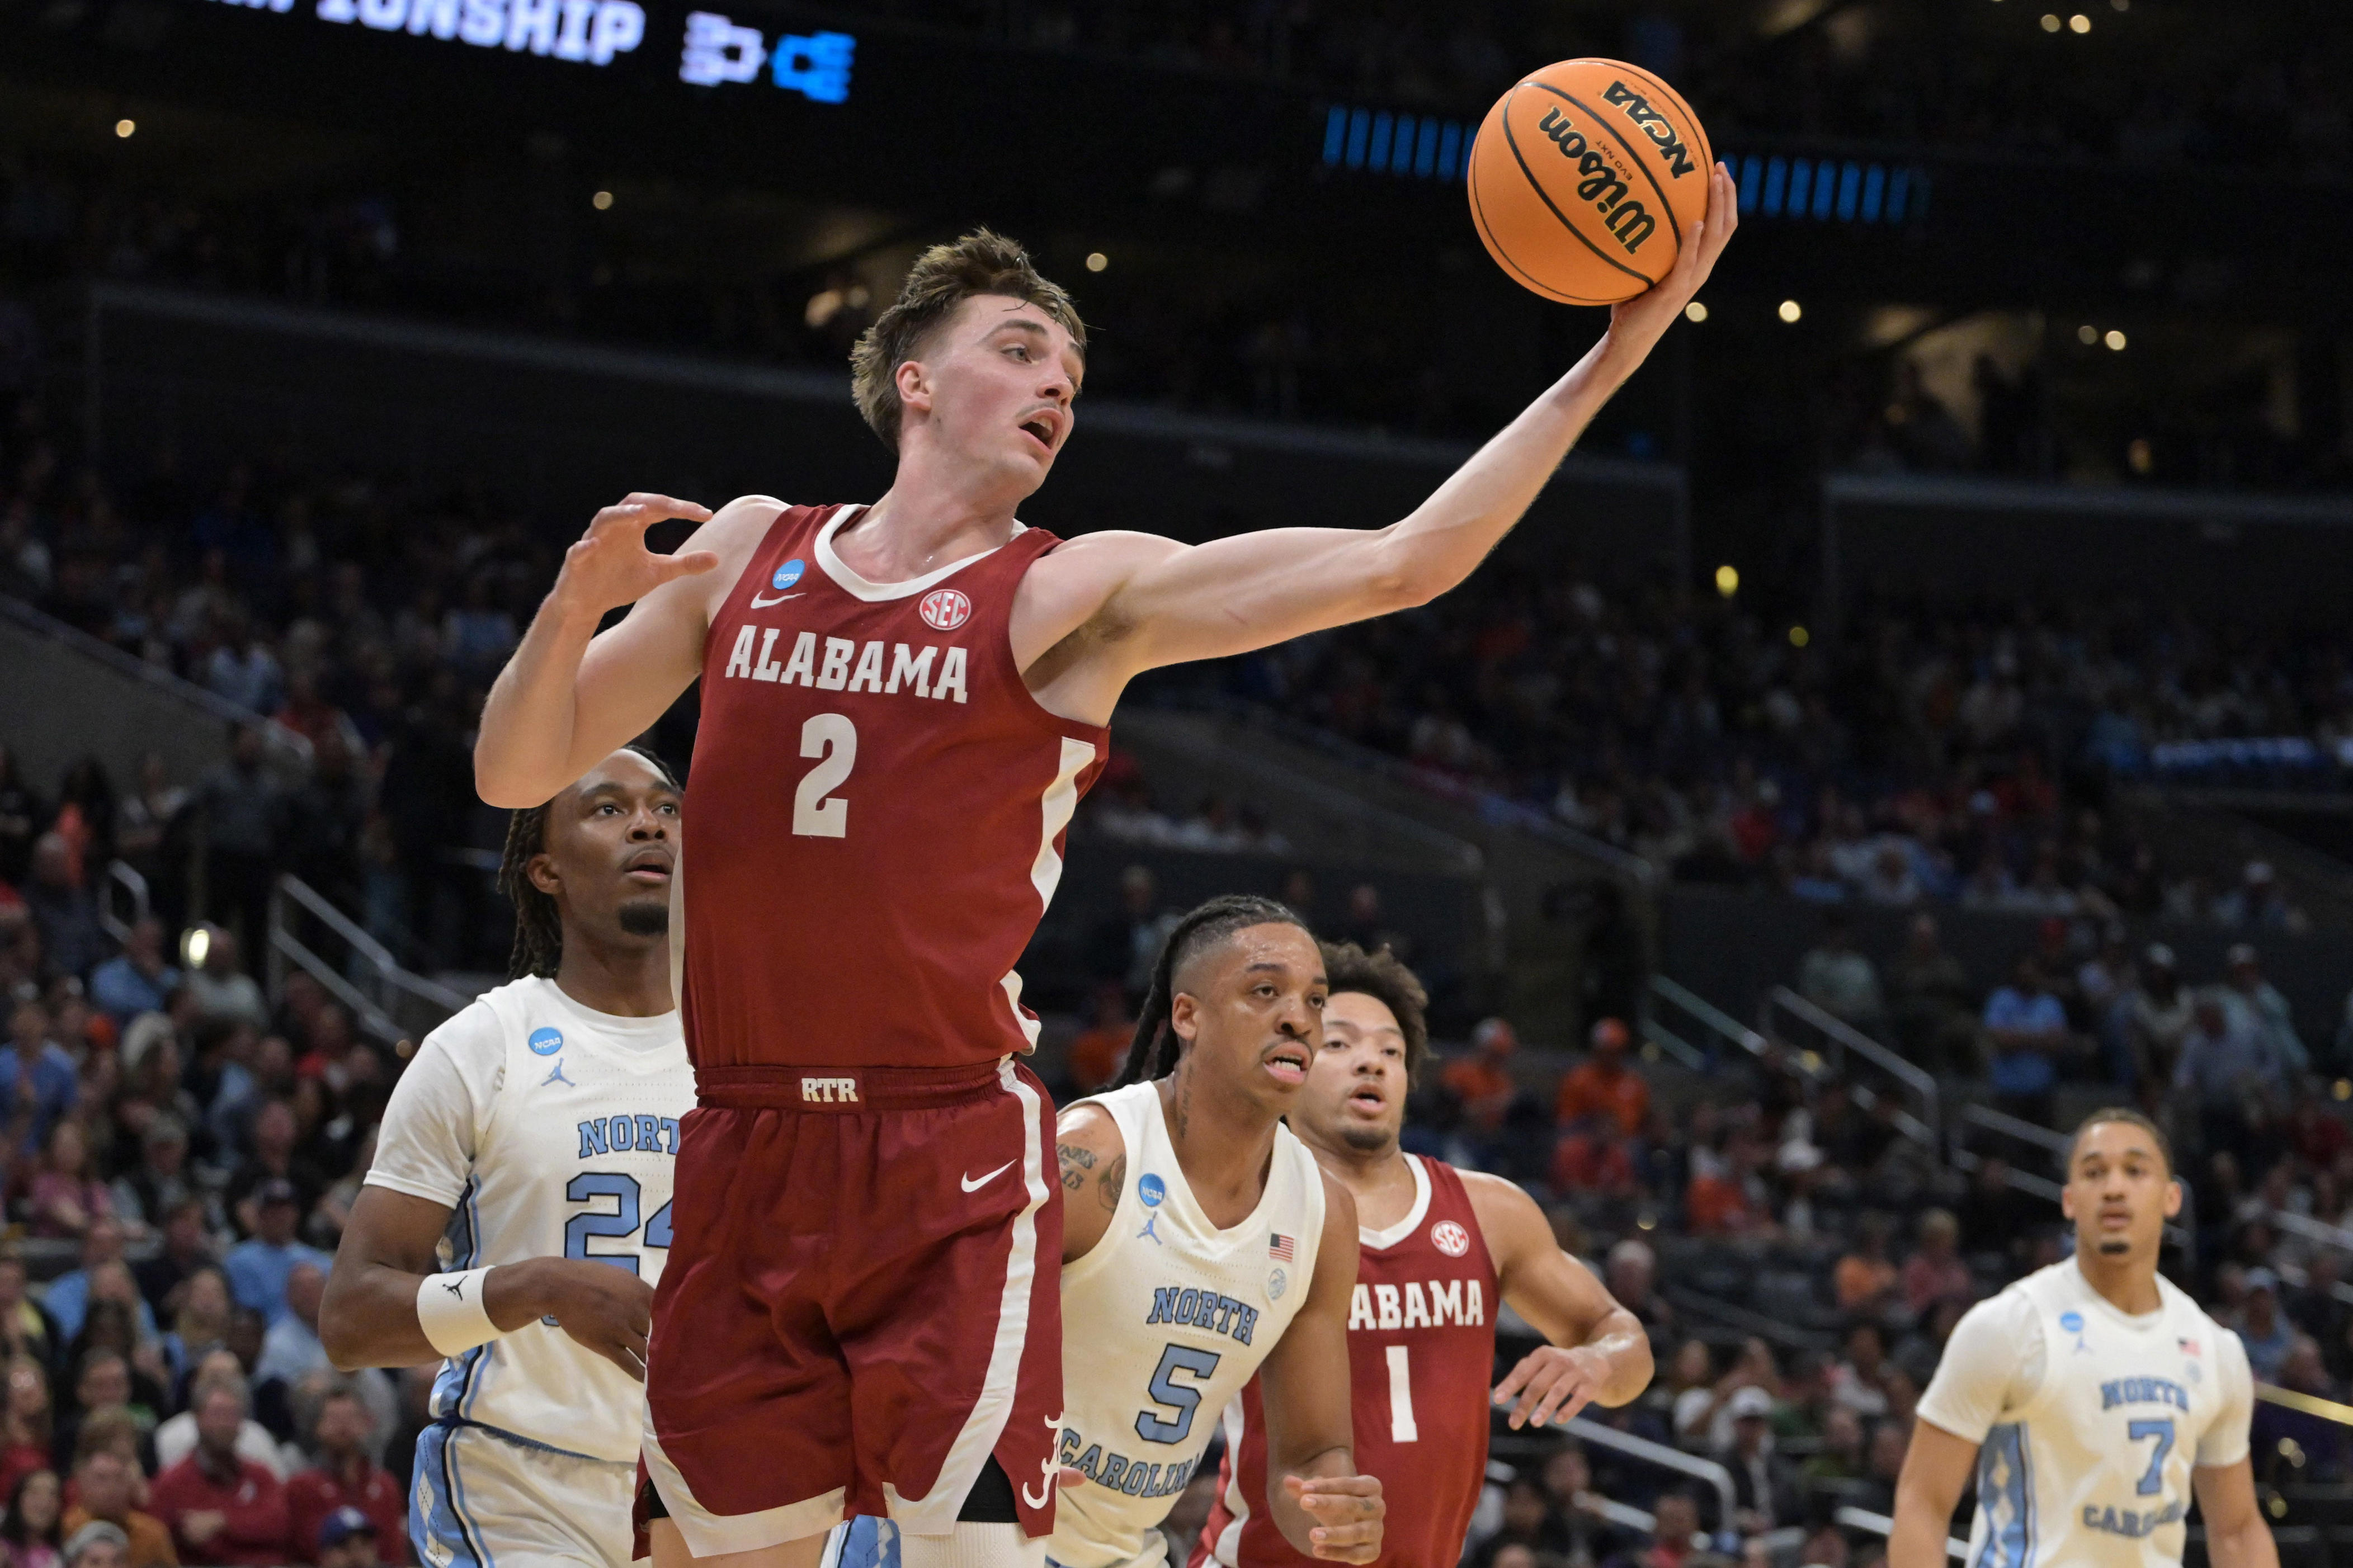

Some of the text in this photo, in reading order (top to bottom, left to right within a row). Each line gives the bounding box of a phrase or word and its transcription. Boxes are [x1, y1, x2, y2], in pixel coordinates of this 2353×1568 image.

[1602, 80, 1696, 180] NCAA
[1539, 106, 1656, 255] Wilson
[1596, 140, 1633, 181] EVO NXT
[924, 592, 966, 627] SEC
[726, 625, 968, 703] ALABAMA
[792, 713, 857, 838] 2
[534, 1037, 561, 1050] NCAA
[801, 1078, 859, 1102] RTR
[1142, 1186, 1163, 1201] NCAA
[1434, 1224, 1466, 1253] SEC
[1147, 1287, 1259, 1346] NORTH
[1348, 1279, 1484, 1330] ABAMA
[1135, 1343, 1221, 1445] 5
[1385, 1345, 1418, 1443] 1
[2101, 1376, 2189, 1413] NORTH
[1061, 1428, 1200, 1498] CAROLIN
[2128, 1418, 2175, 1496] 7
